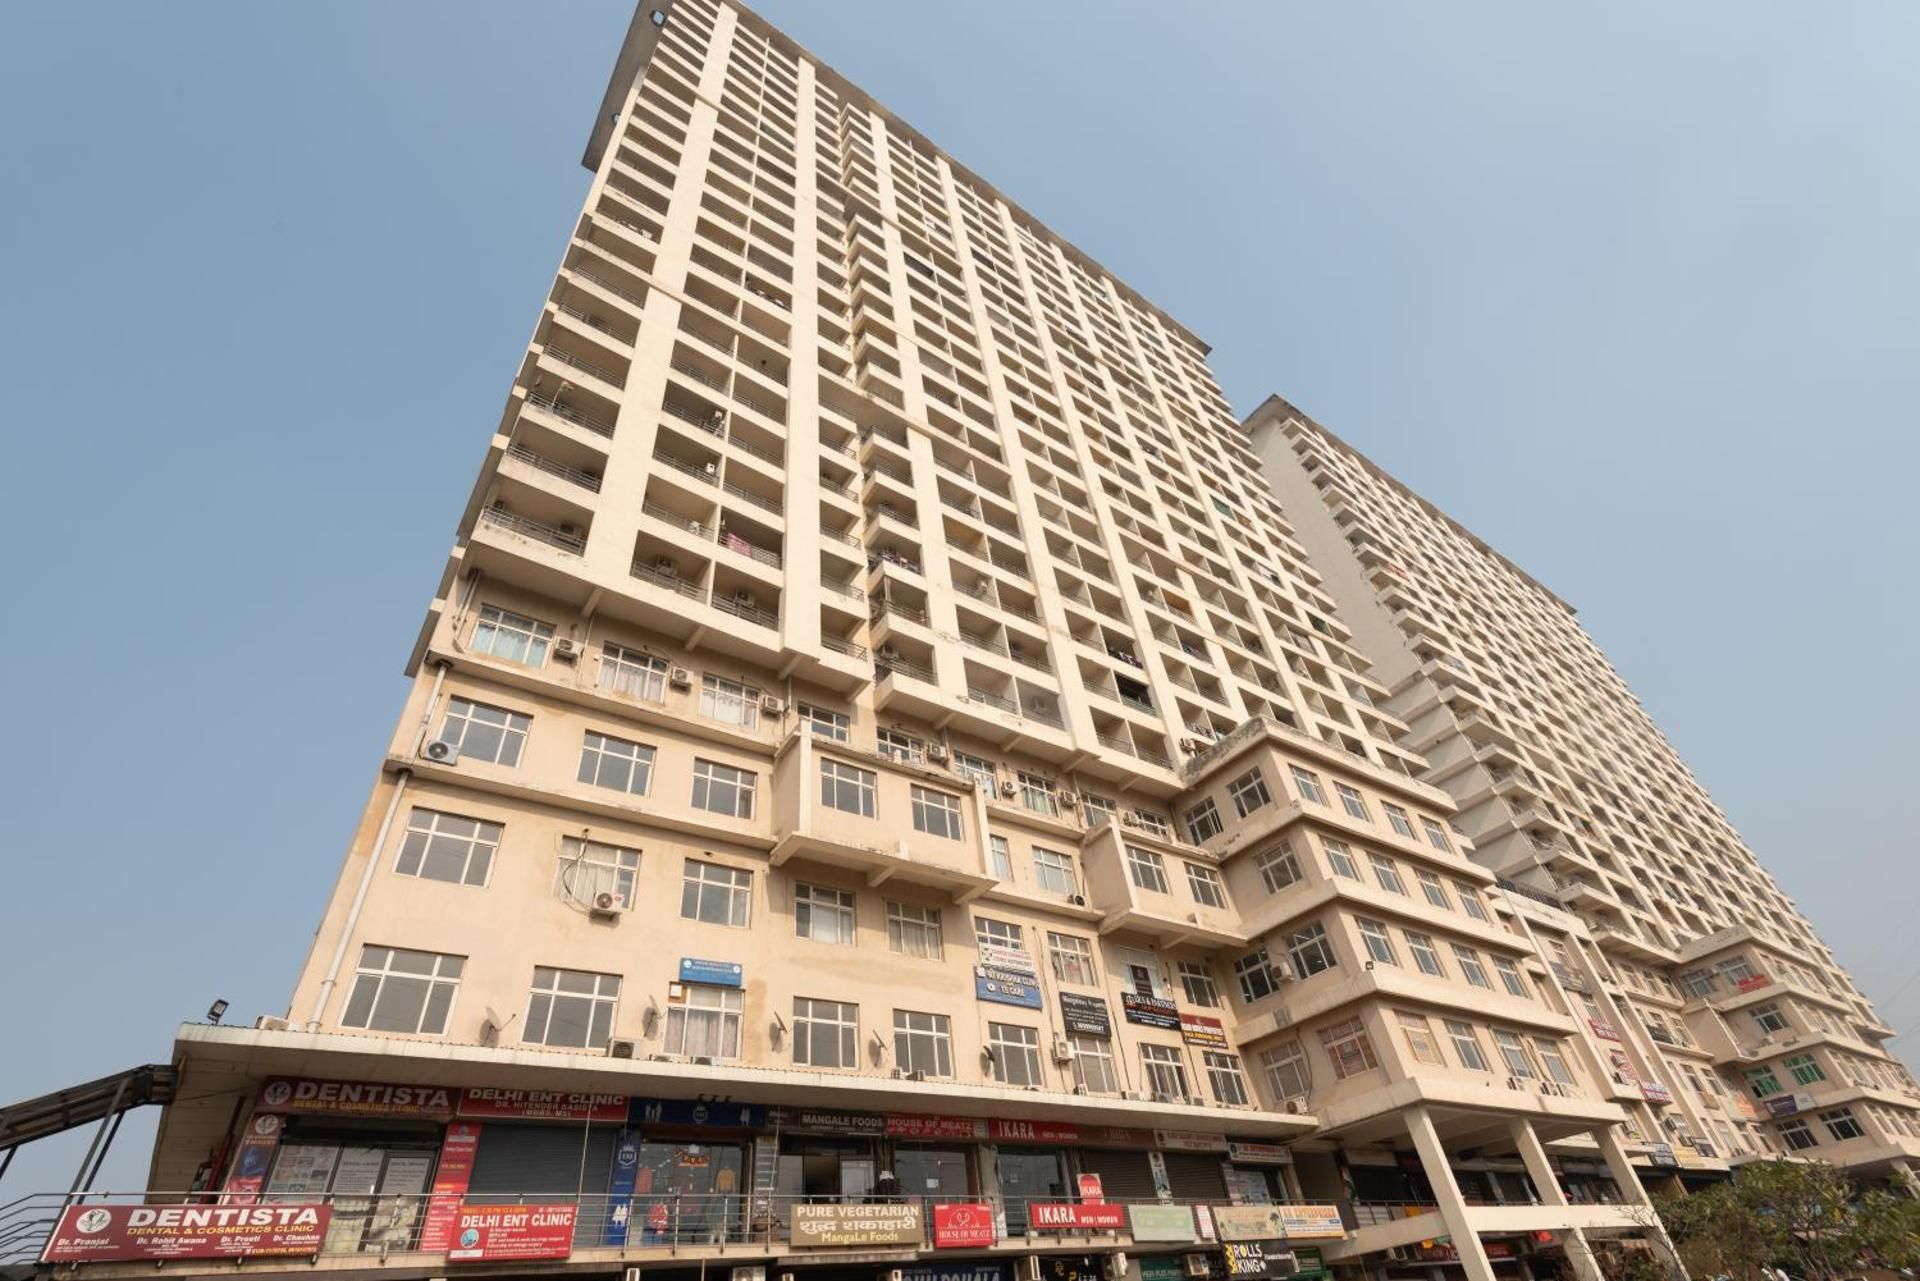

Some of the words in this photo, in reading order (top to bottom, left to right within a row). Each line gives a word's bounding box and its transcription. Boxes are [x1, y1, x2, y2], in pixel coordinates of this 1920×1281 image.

[295, 1082, 449, 1106] DENTISTA
[469, 1088, 524, 1100] DELHI
[529, 1091, 565, 1103] ENT
[568, 1094, 624, 1105] CLINIC
[802, 1114, 850, 1126] MANGALE
[852, 1117, 883, 1127] FOODS
[887, 1117, 922, 1127] HOUSE
[925, 1119, 938, 1128] OF
[999, 1120, 1035, 1140] IKARA
[127, 1208, 319, 1227] DENTISTA
[797, 1206, 834, 1217] PURE
[838, 1206, 919, 1217] VEGETARIAN
[1038, 1207, 1076, 1223] IKARA
[461, 1215, 500, 1228] DELHI
[503, 1214, 529, 1227] ENT
[532, 1213, 572, 1227] CLINIC
[127, 1227, 180, 1235] DENTAL
[197, 1226, 273, 1234] COSMETICS
[870, 1231, 898, 1241] Foods
[57, 1238, 70, 1246] Dr.
[1233, 1244, 1262, 1258] ROLLS
[1236, 1259, 1261, 1273] KING
